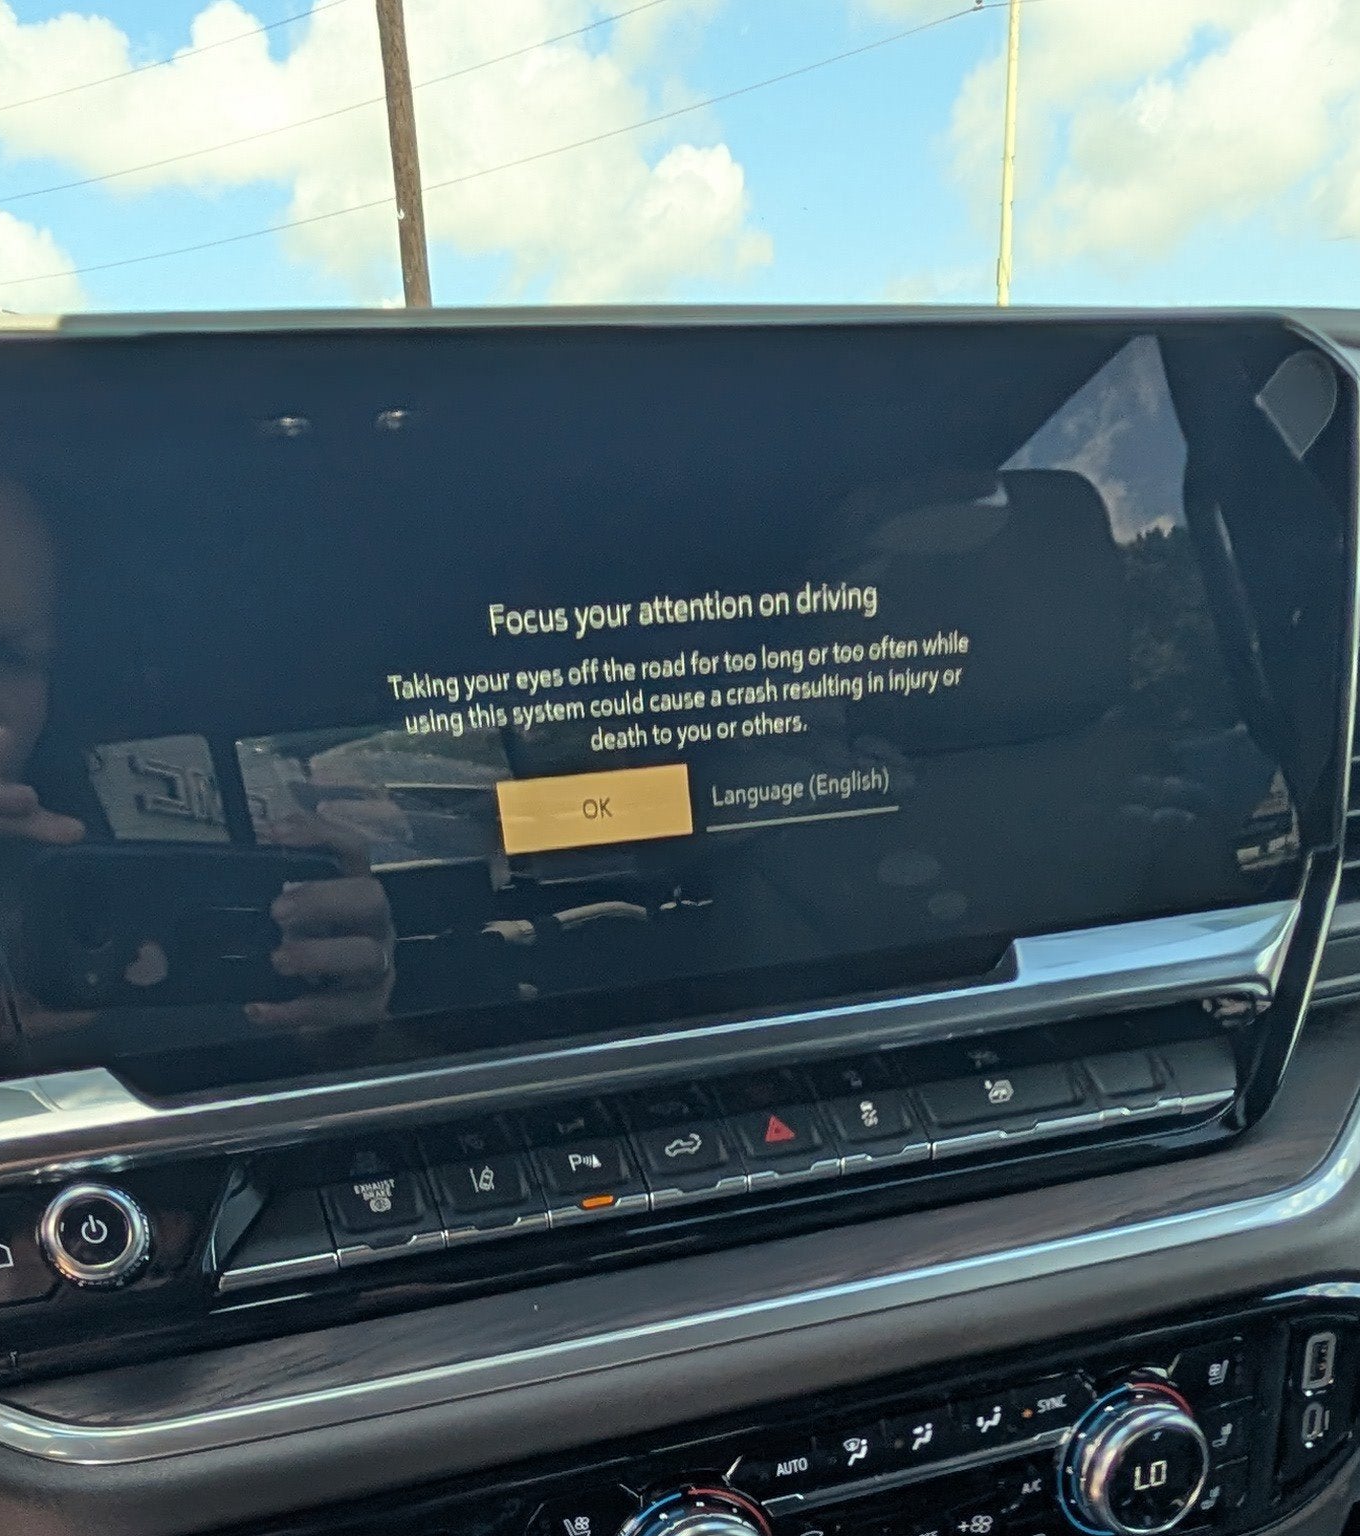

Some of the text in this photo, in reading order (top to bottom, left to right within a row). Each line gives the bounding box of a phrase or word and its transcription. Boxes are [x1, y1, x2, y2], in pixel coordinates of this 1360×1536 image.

[489, 581, 878, 640] Focus your attention on driving
[387, 630, 970, 703] Taking your eyes off the road for too long or too often while
[406, 667, 962, 737] using this system could cause a crash resulting in injury or
[591, 711, 808, 751] death to you or others.
[712, 765, 890, 809] Language (English)
[582, 797, 613, 820] OK
[1037, 1394, 1067, 1413] SYNC
[776, 1457, 808, 1477] AUTO
[1134, 1460, 1167, 1491] LO
[1021, 1478, 1042, 1495] A/C
